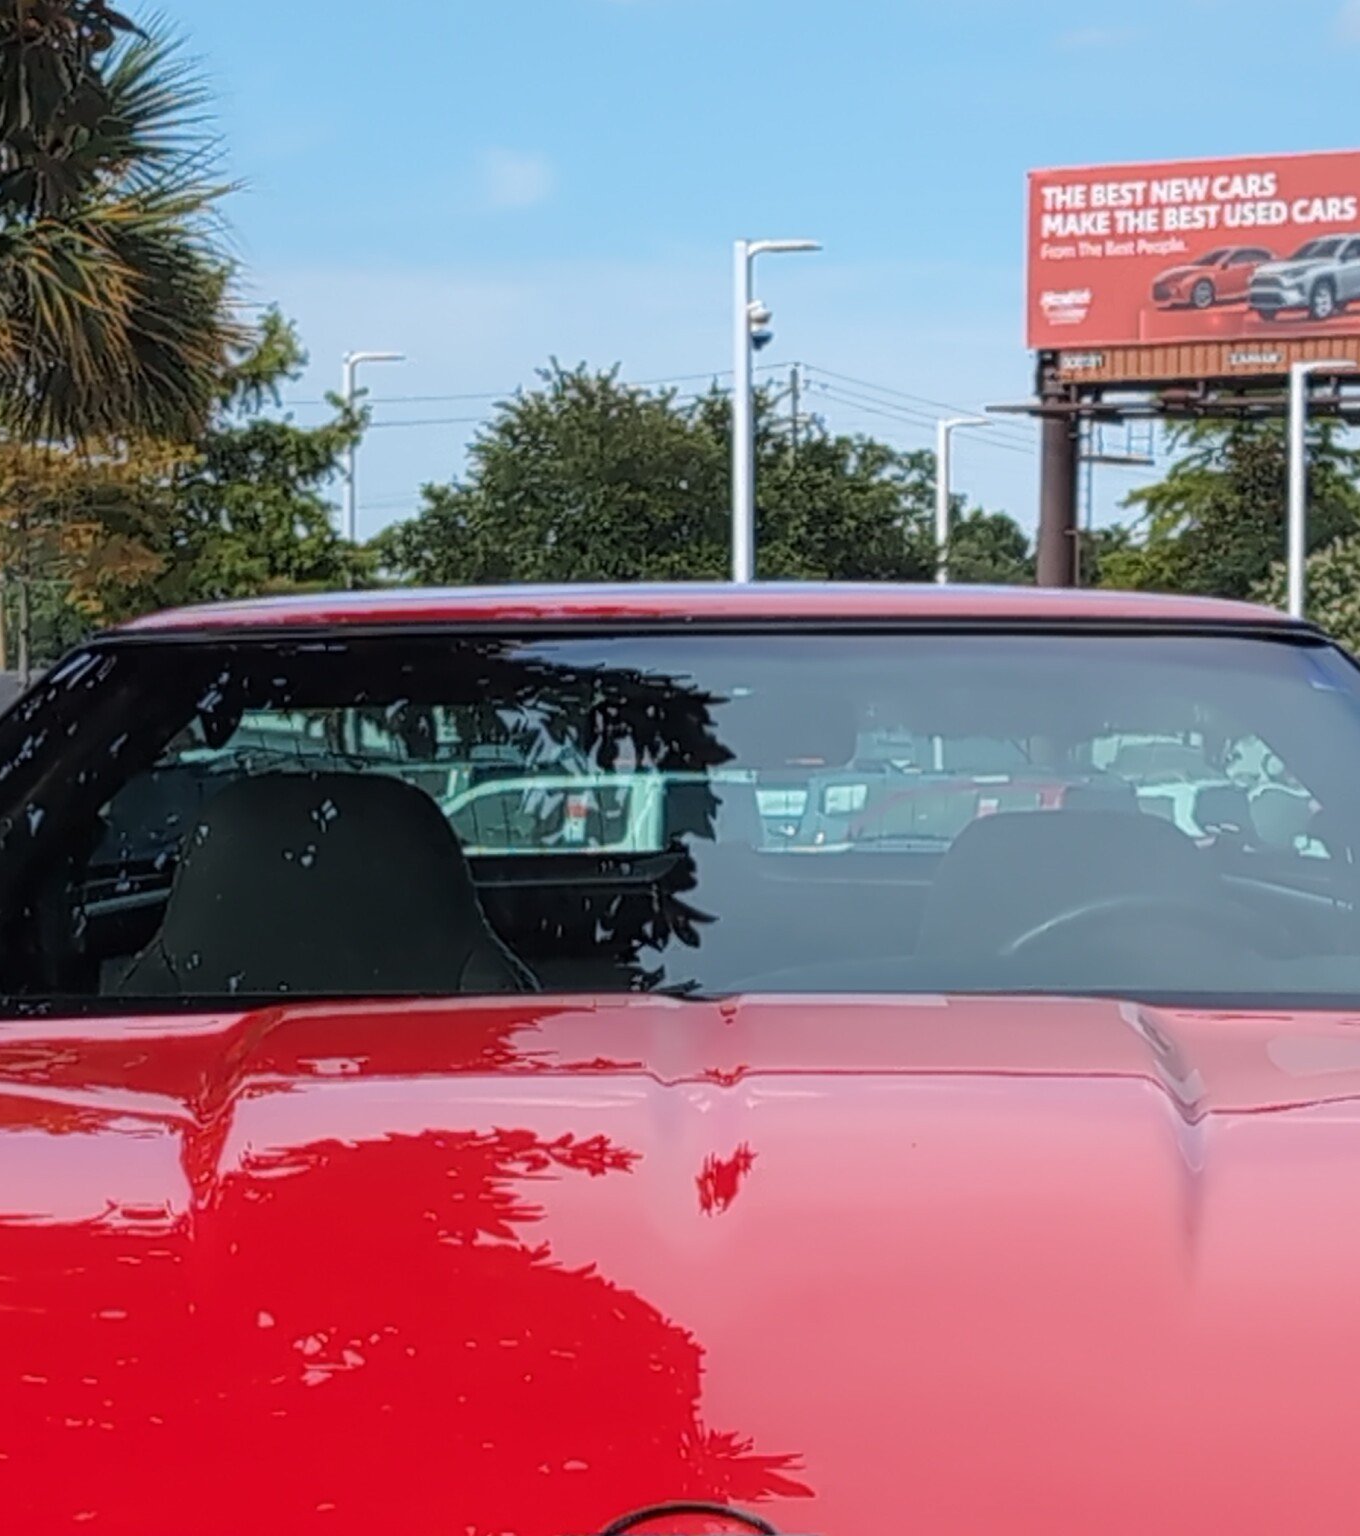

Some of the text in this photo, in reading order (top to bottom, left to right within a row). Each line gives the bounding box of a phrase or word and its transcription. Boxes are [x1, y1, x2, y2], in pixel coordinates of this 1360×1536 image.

[1041, 171, 1277, 211] THE BEST NEW CARS
[1041, 195, 1358, 238] MAKE THE BEST USED CARS
[1041, 242, 1076, 260] From
[1078, 240, 1102, 257] The
[1105, 240, 1135, 256] Best
